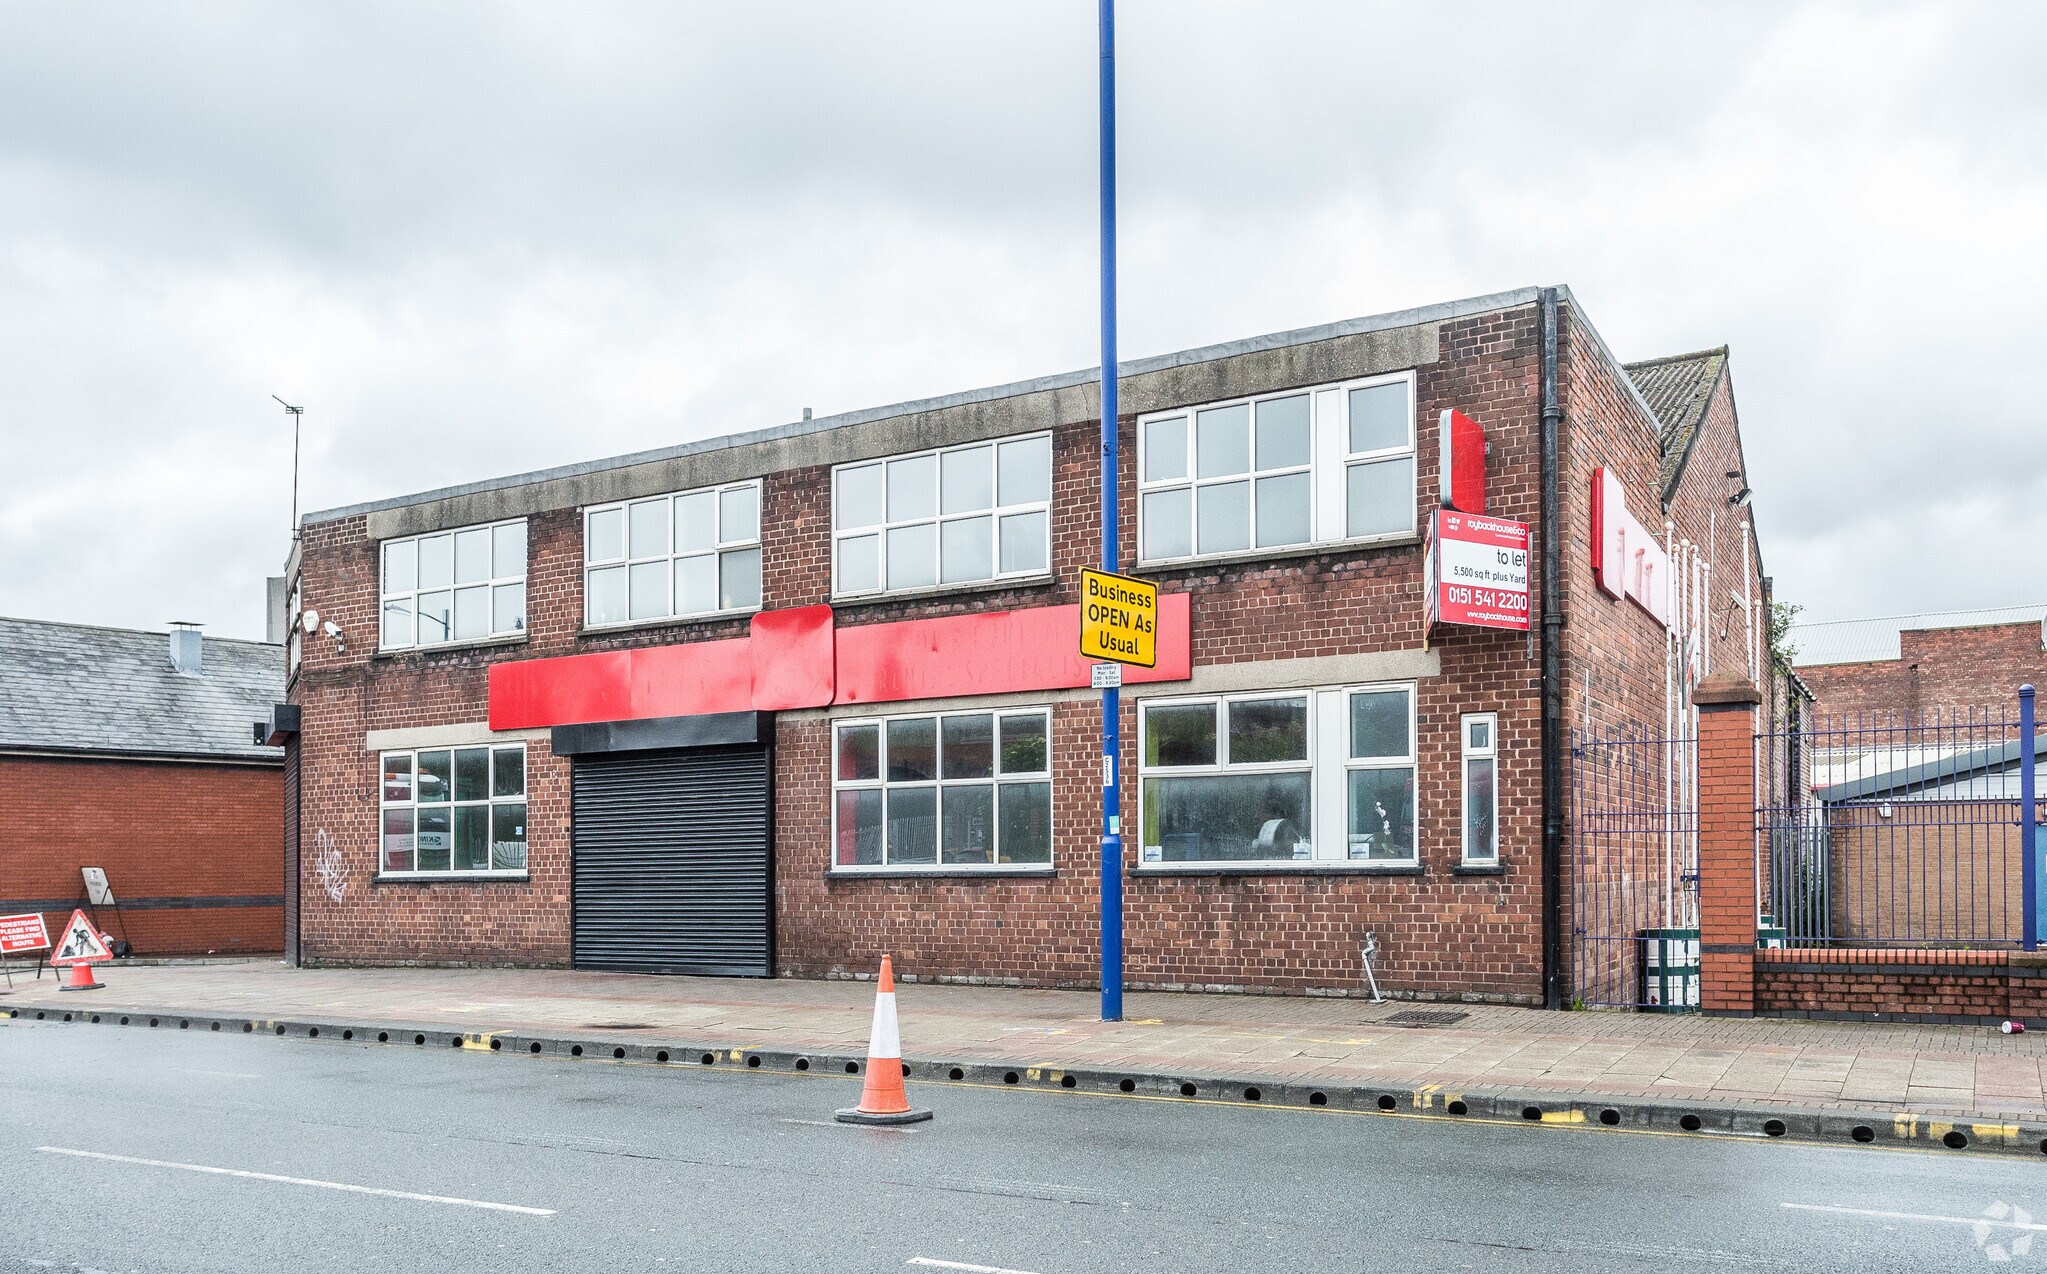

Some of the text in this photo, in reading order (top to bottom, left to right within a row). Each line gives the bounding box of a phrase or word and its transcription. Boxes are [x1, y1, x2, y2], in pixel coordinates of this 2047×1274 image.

[1467, 519, 1526, 536] roybackhouse&co
[1497, 548, 1526, 567] to let
[1454, 565, 1526, 584] 5,500 sq ft plus Yard
[1089, 577, 1152, 608] Business
[1448, 586, 1528, 611] 0151 541 2200
[1088, 603, 1152, 634] OPEN As
[1466, 611, 1528, 623] www.roybackhouse.com
[1099, 630, 1139, 656] Usual
[12, 939, 35, 947] ROUTE
